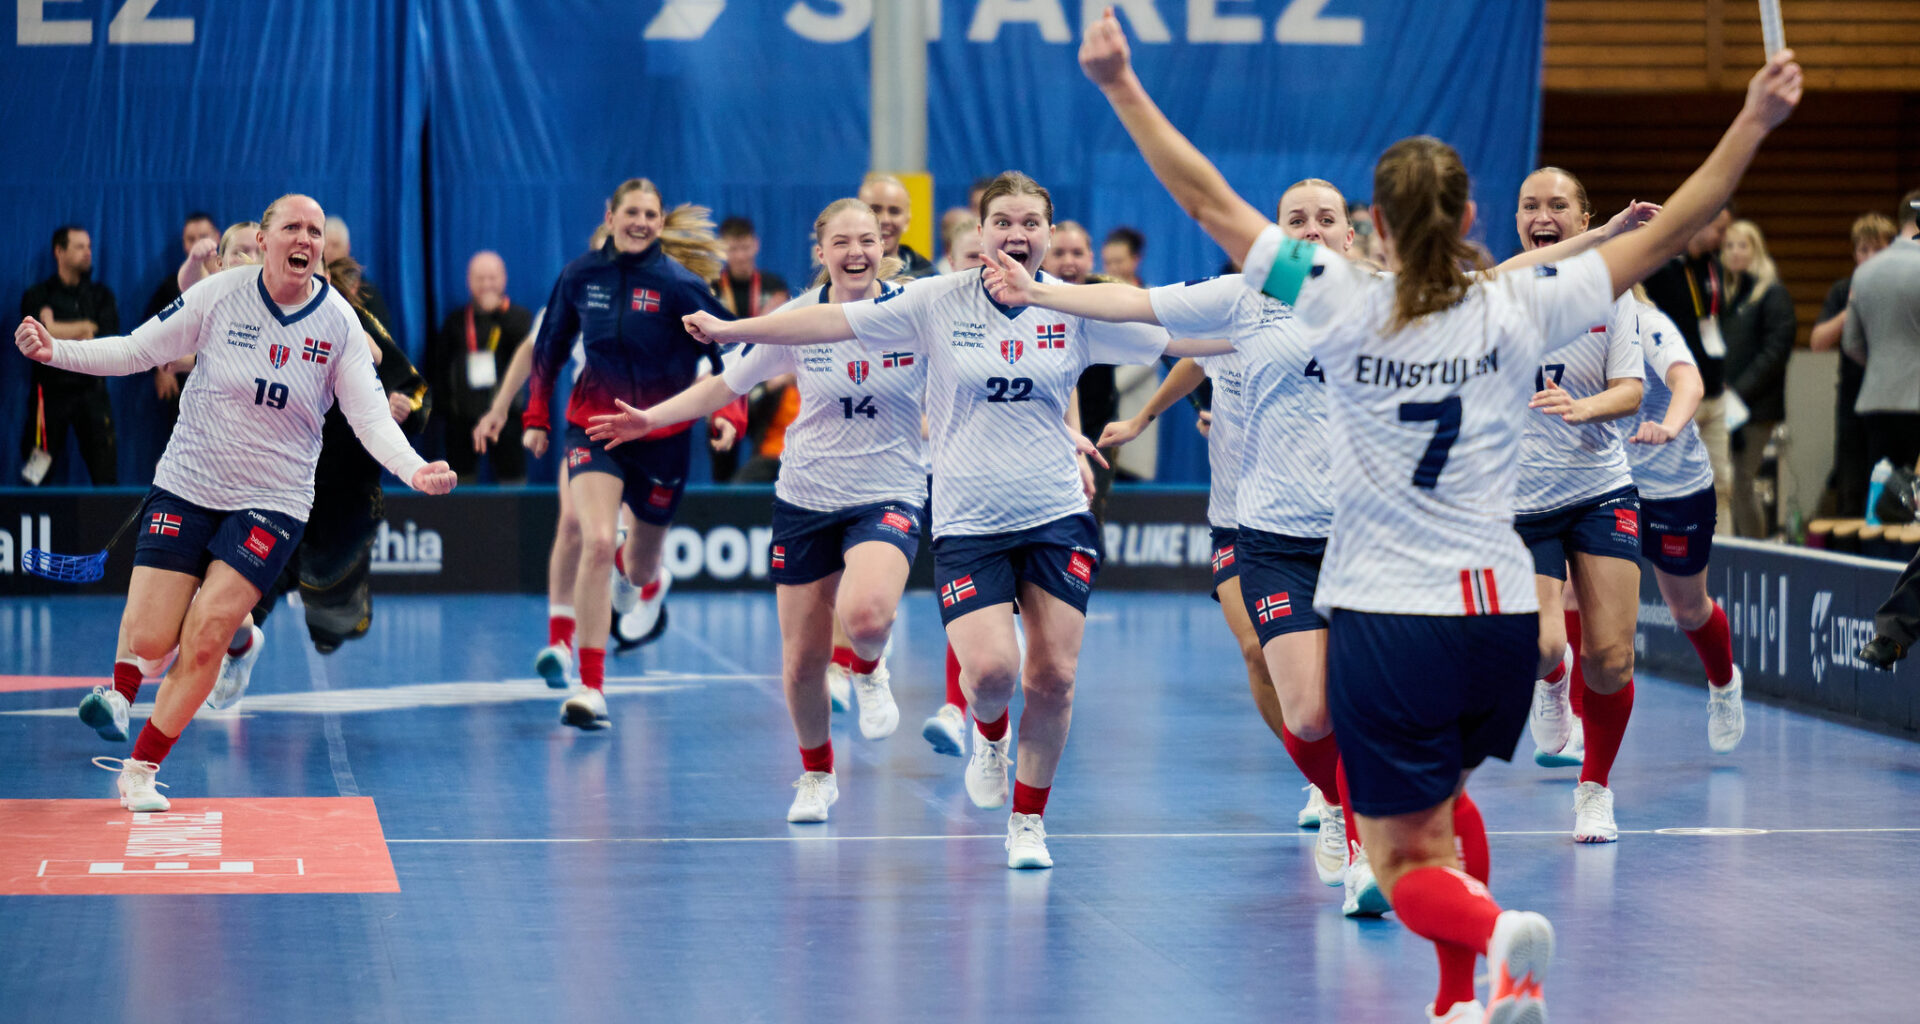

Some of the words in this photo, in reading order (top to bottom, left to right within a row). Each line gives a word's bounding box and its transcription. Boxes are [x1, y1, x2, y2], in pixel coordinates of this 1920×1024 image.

[254, 378, 289, 410] 19
[986, 376, 1033, 403] 22
[839, 395, 878, 419] 14
[1398, 395, 1463, 490] 7
[1124, 523, 1184, 566] LIKE
